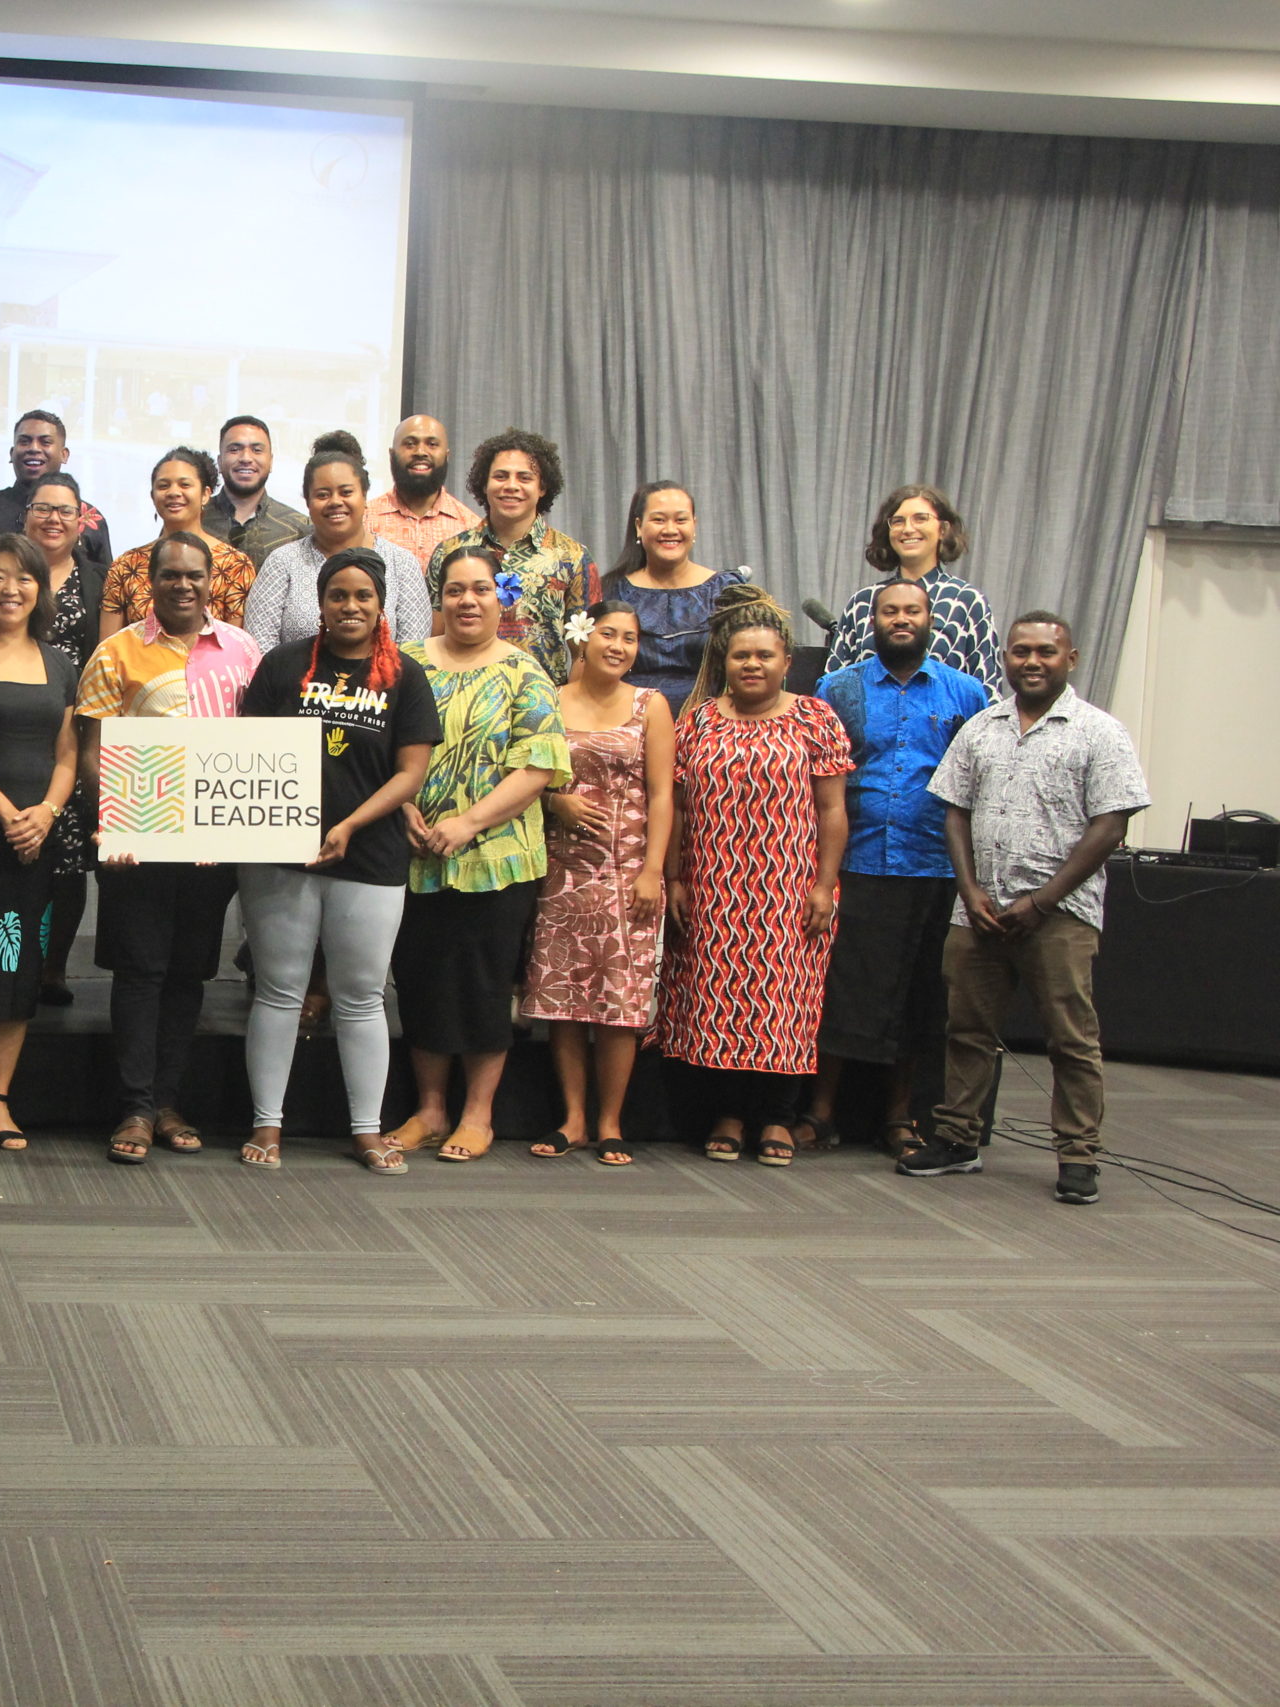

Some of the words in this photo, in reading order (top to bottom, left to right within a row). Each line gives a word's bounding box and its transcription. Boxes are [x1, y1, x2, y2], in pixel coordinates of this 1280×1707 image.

[334, 711, 359, 721] YOUR
[363, 716, 386, 728] TRIBE
[195, 752, 297, 774] YOUNG
[194, 779, 299, 800] PACIFIC
[194, 805, 320, 827] LEADERS
